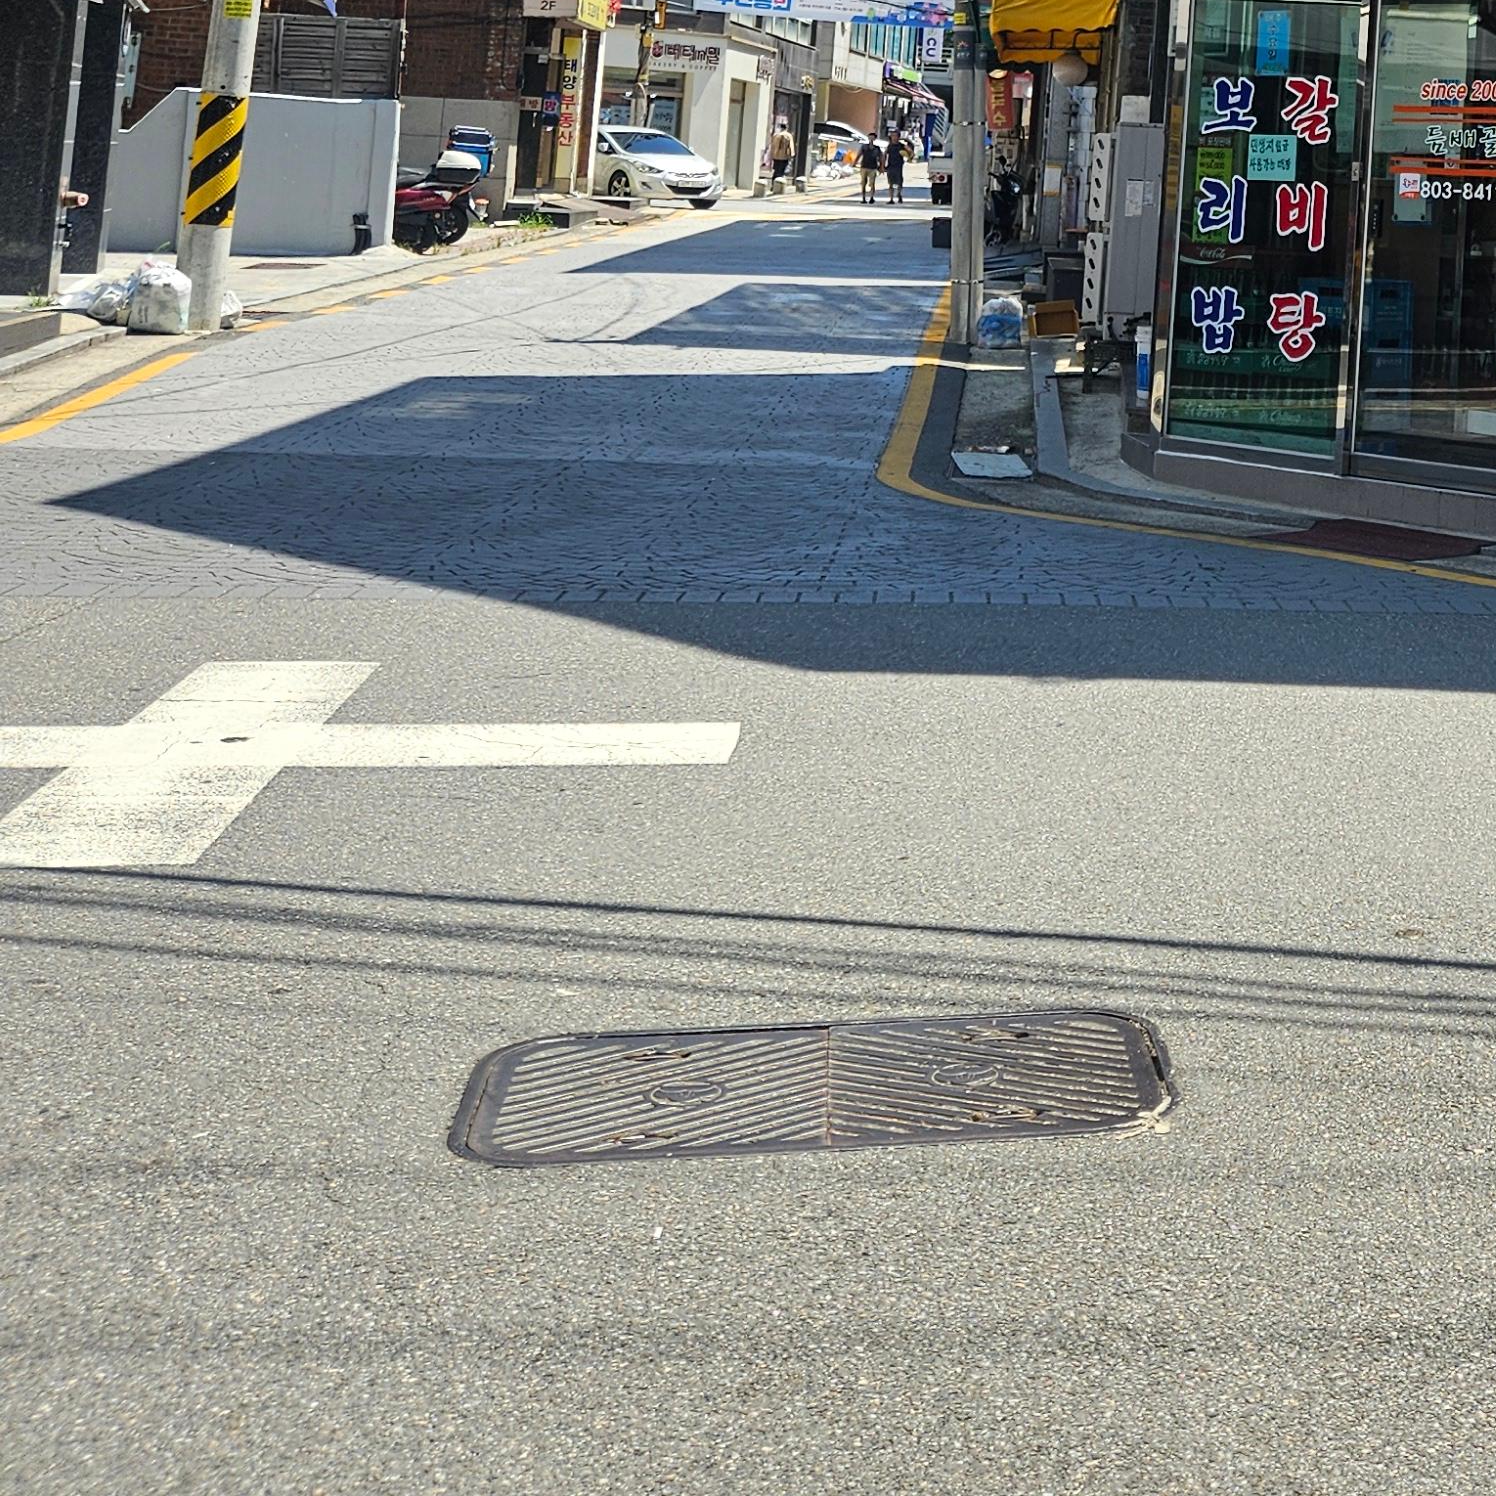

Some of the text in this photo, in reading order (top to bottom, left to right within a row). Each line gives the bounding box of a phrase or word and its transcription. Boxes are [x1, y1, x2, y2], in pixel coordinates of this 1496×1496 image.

[540, 0, 557, 11] 2F
[557, 59, 578, 147] 태양 부동산
[1420, 78, 1469, 101] since
[1191, 77, 1257, 354] 보리밥
[1267, 75, 1339, 362] 갈비탕
